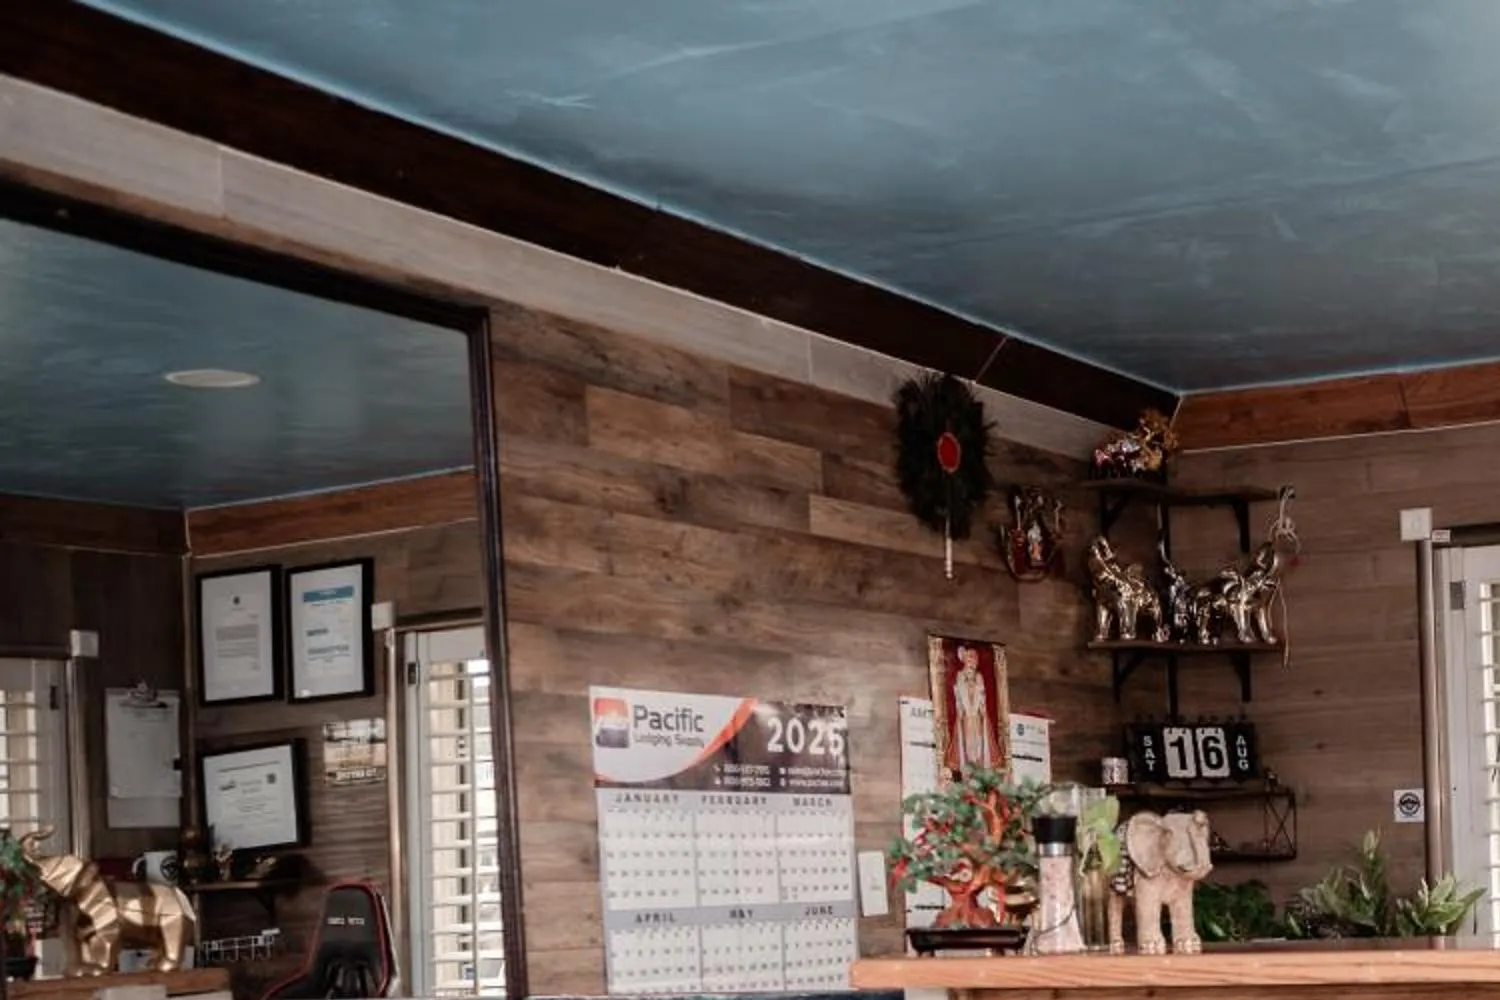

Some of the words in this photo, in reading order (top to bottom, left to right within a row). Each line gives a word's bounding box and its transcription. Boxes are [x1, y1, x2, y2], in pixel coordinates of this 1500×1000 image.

[633, 704, 705, 733] Pacific
[1142, 735, 1156, 772] SAT
[1235, 735, 1250, 771] AUG
